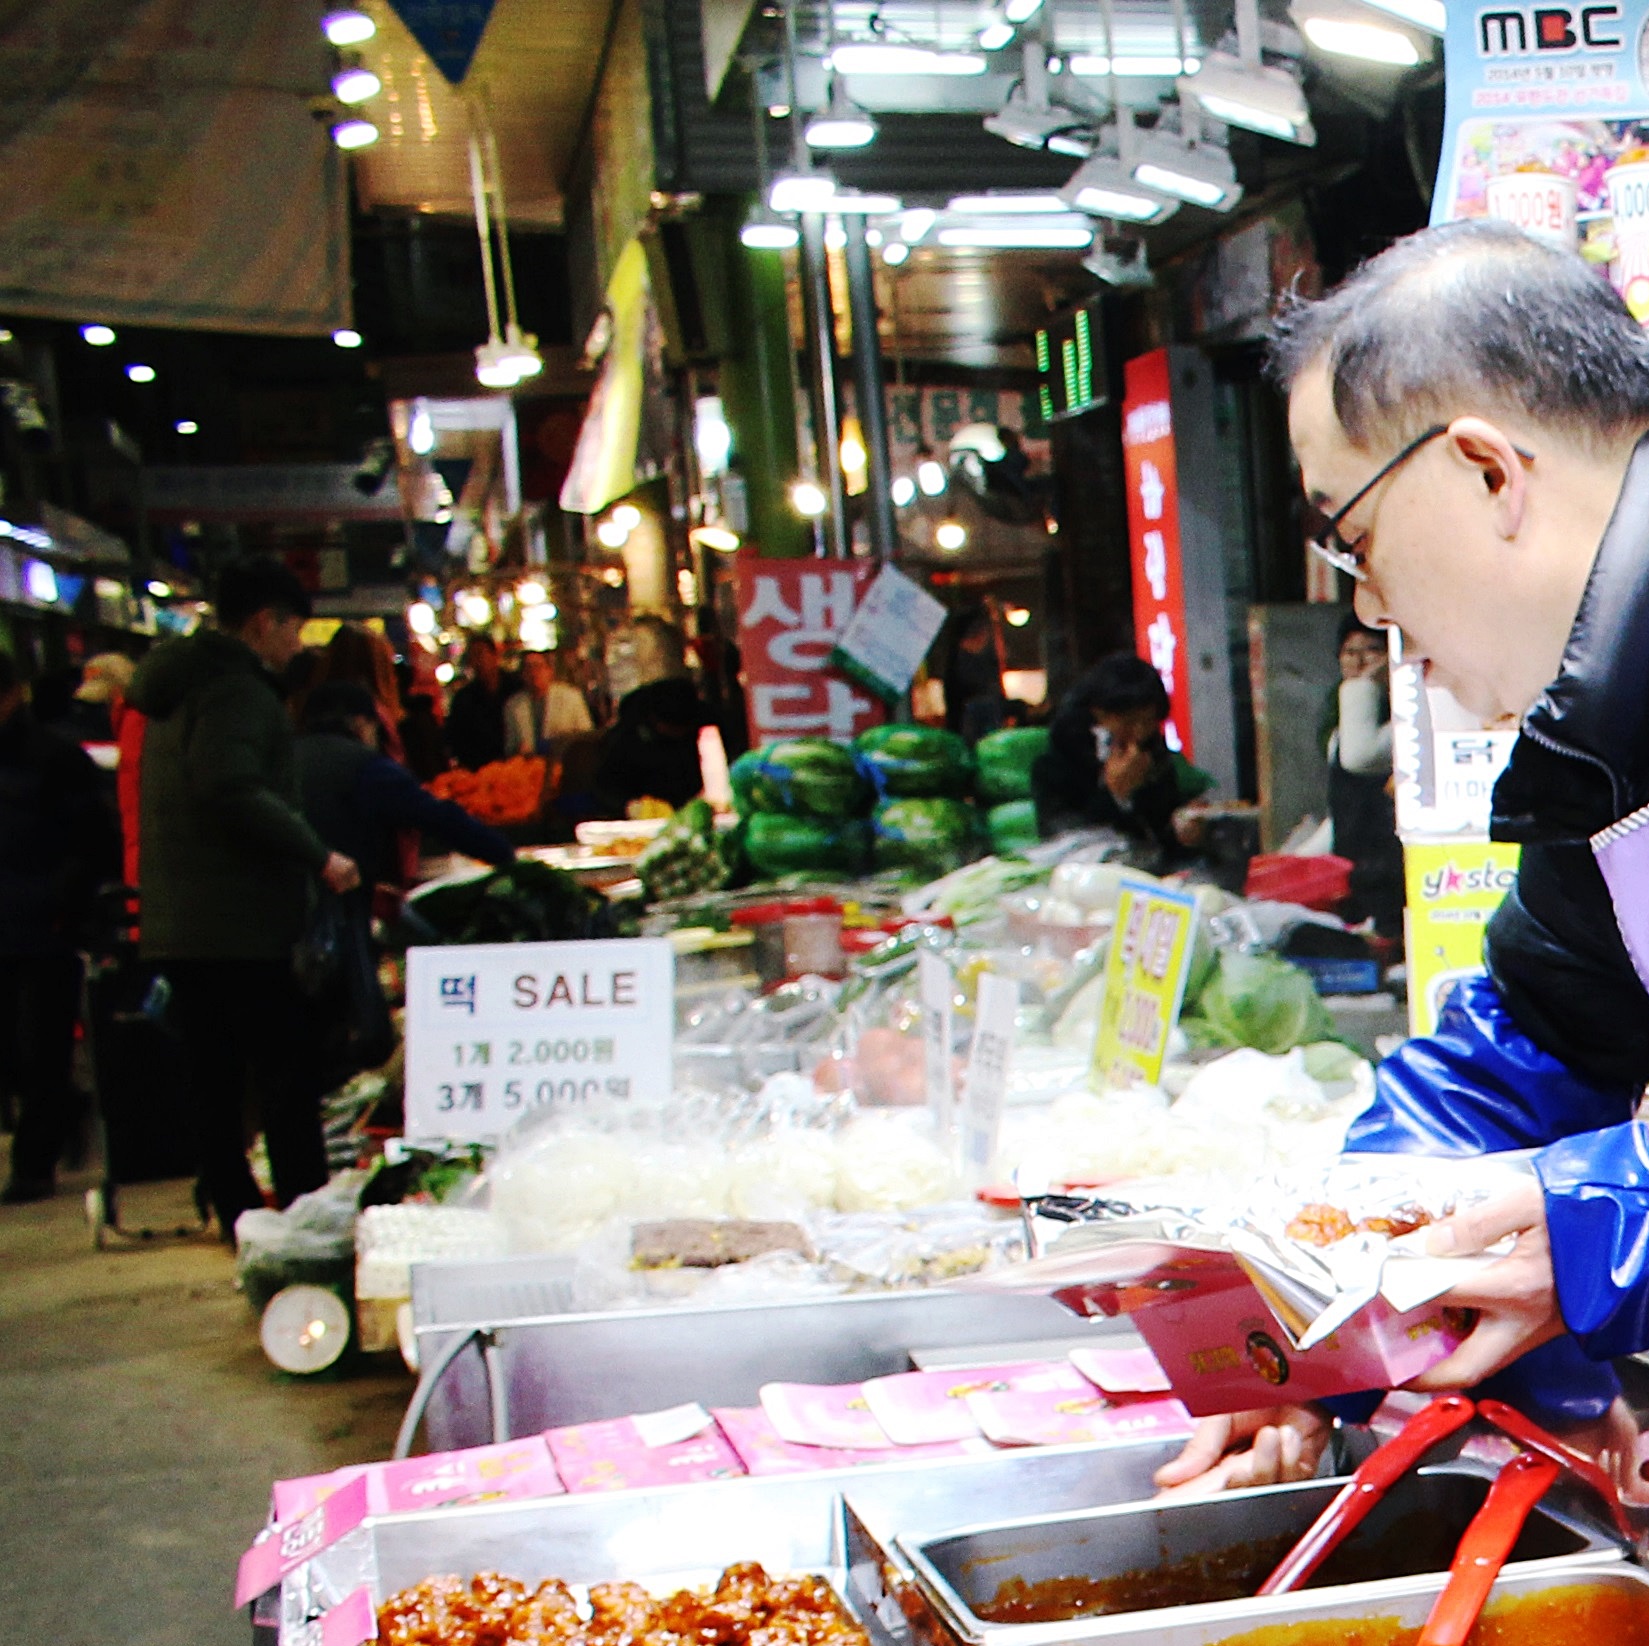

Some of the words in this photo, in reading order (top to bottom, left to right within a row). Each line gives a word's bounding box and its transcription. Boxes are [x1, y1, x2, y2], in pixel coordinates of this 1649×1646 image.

[1479, 3, 1622, 54] MBC
[439, 974, 475, 1015] 떡
[513, 970, 637, 1010] SALE
[454, 1041, 491, 1066] 1개
[437, 1083, 484, 1112] 3개
